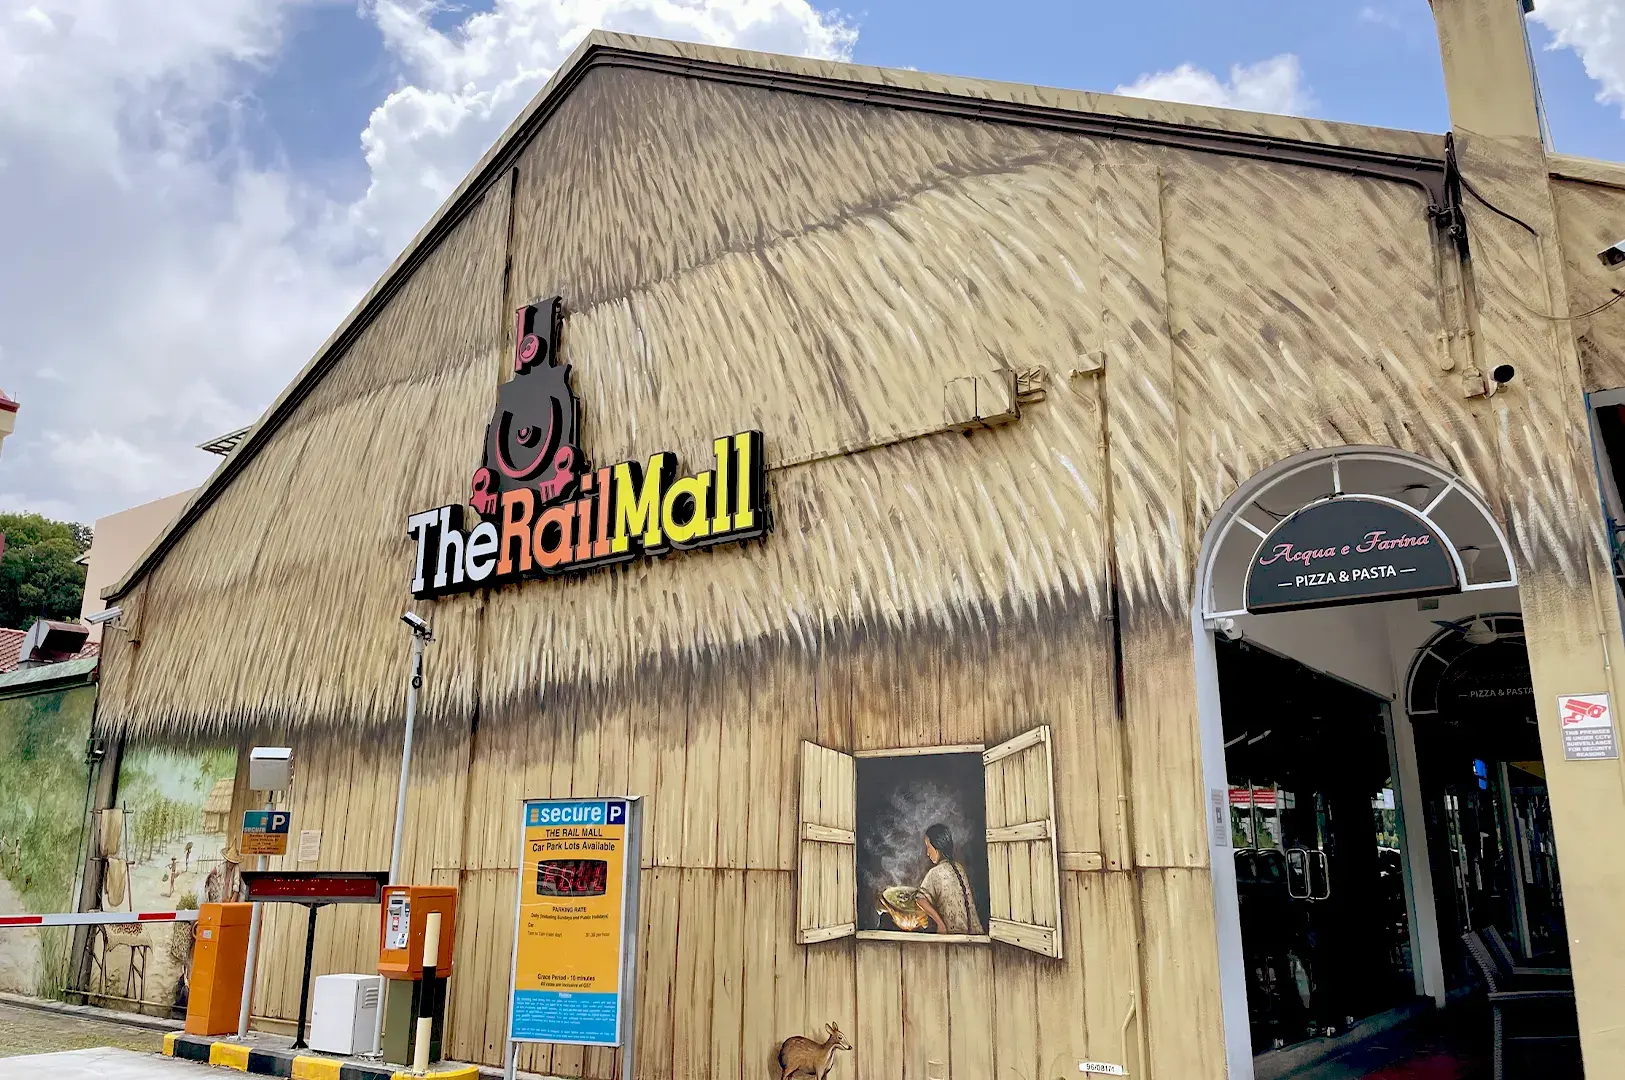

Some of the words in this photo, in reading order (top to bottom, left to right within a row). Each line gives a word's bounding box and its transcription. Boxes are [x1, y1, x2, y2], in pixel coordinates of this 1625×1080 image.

[1259, 542, 1336, 566] Acqua
[1341, 544, 1350, 556] e
[1355, 530, 1430, 553] Farina
[1295, 569, 1336, 587] PIZZA
[1339, 569, 1350, 583] &
[1352, 565, 1397, 580] PASTA
[1470, 689, 1496, 698] PIZZA
[1506, 687, 1534, 696] PASTA
[540, 806, 602, 823] secure
[610, 806, 622, 822] P
[272, 815, 286, 831] P
[546, 829, 561, 838] THE
[562, 829, 580, 837] RAIL
[582, 828, 603, 837] MALL
[532, 843, 545, 852] Car
[547, 842, 563, 851] Park
[565, 842, 580, 850] Lots
[582, 841, 615, 851] Available
